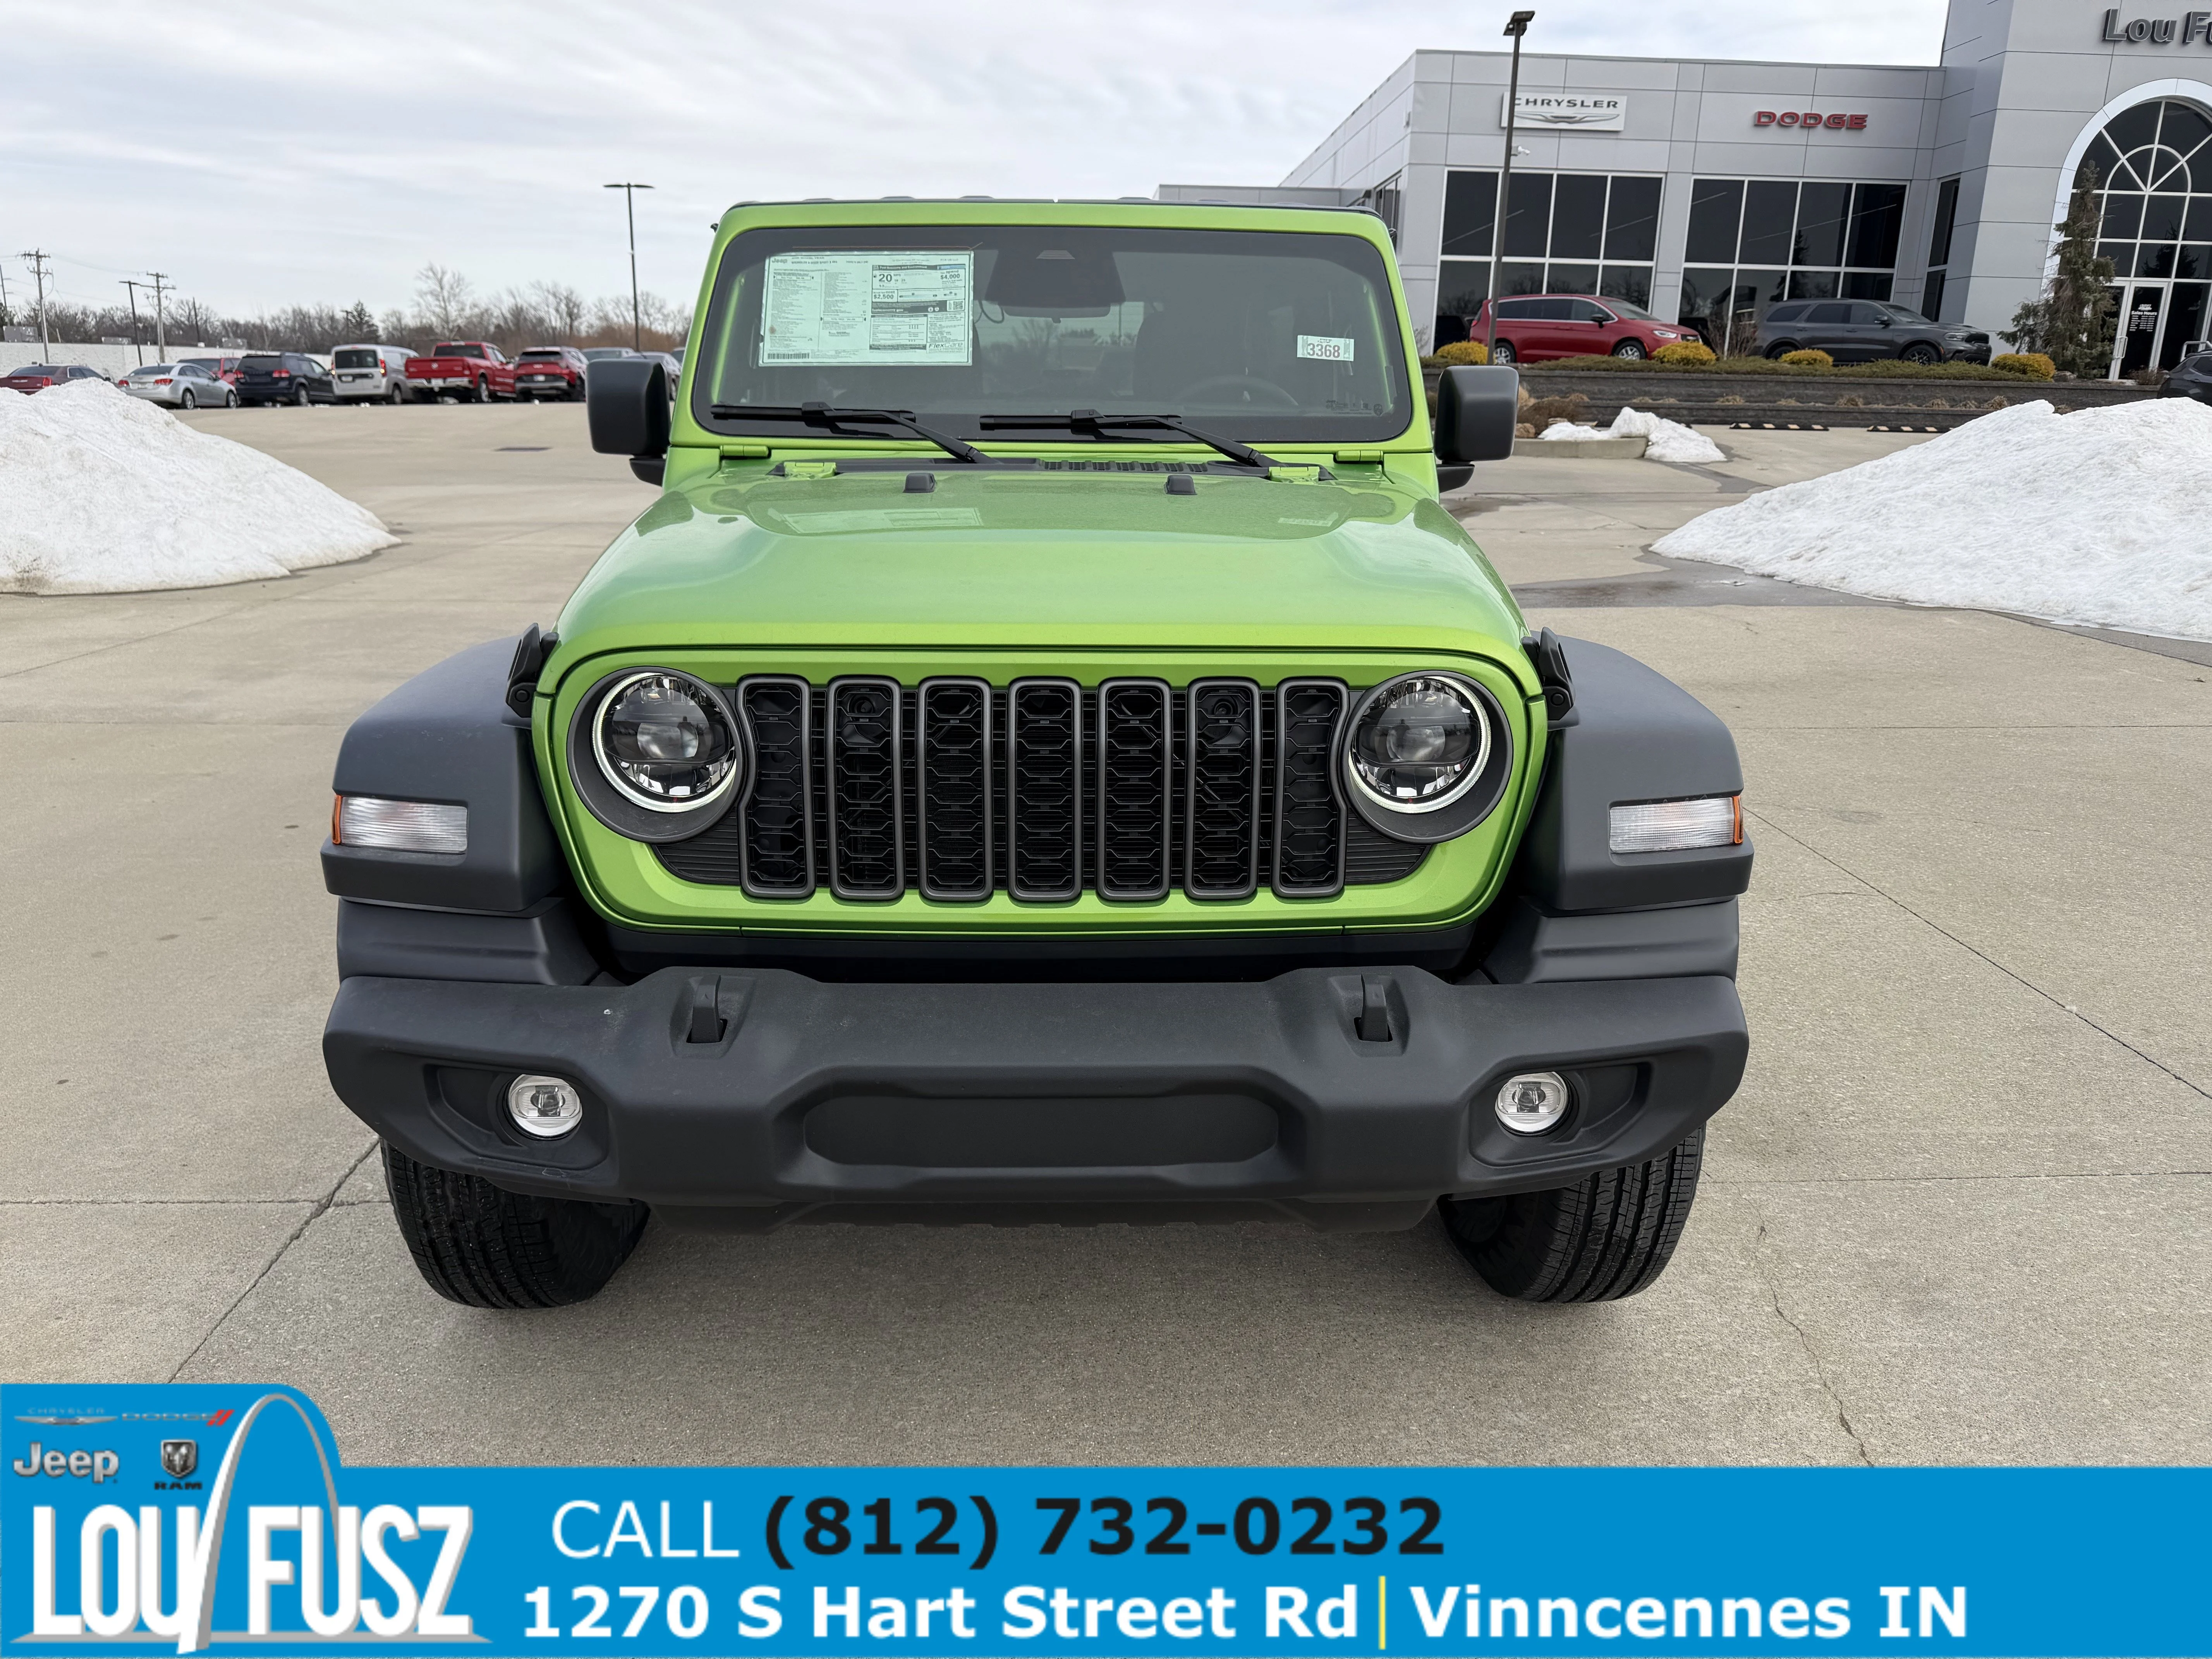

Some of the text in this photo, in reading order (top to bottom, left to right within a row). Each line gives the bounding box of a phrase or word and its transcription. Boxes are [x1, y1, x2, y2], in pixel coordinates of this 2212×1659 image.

[2103, 9, 2177, 42] Lou
[1754, 111, 1869, 129] DODGE
[879, 273, 892, 282] 20
[1307, 343, 1340, 358] 3368
